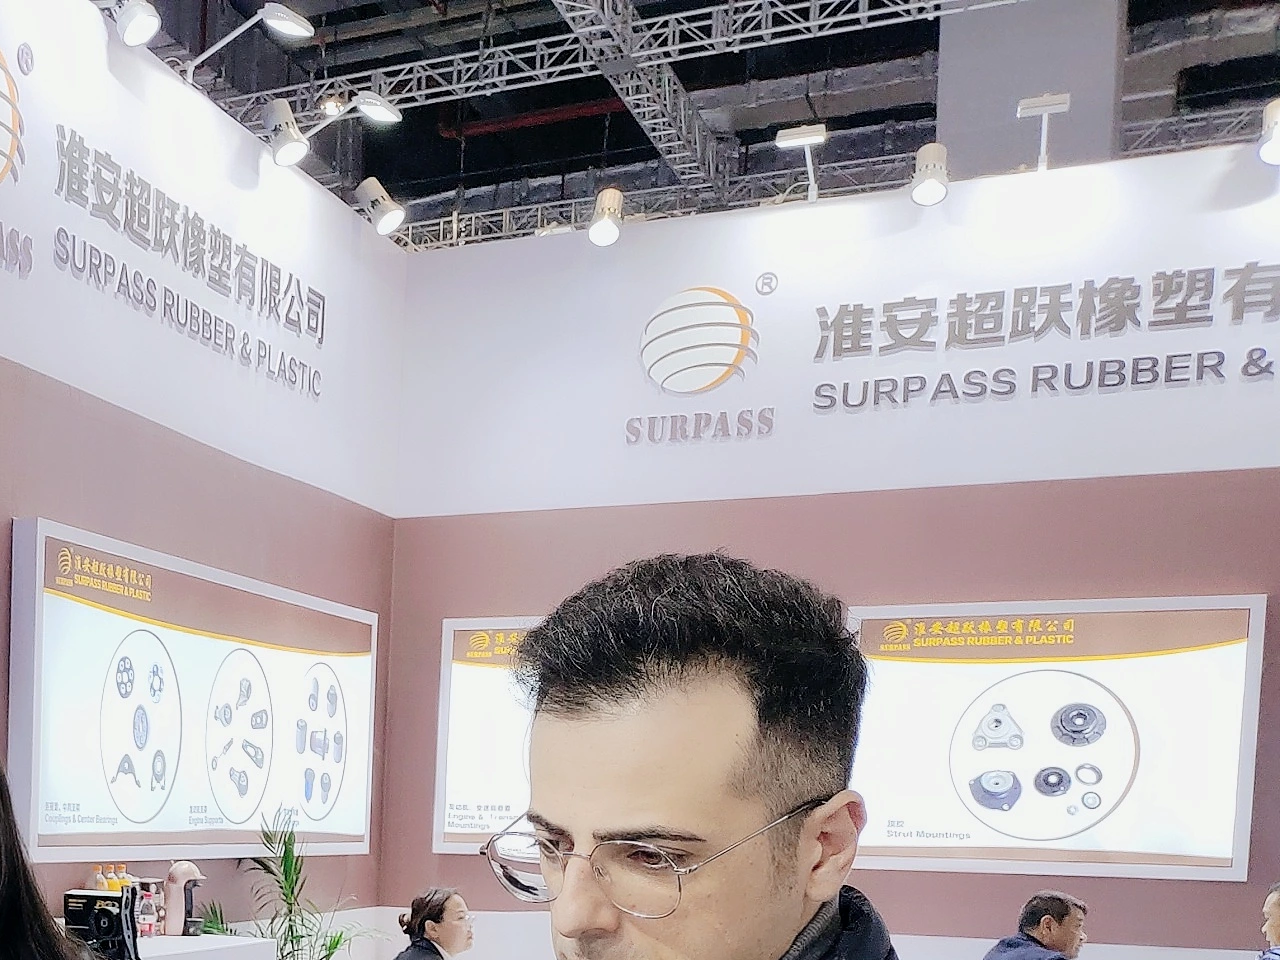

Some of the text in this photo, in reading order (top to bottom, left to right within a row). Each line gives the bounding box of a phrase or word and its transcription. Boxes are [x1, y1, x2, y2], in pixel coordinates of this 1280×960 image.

[55, 124, 326, 346] 淮安超跃橡塑有限公司
[54, 227, 322, 397] SURPASS RUBBER & PLASTIC
[814, 261, 1280, 361] 淮安超跃橡塑有
[813, 347, 1275, 410] SURPASS RUBBER &
[625, 408, 774, 445] SURPASS
[74, 573, 101, 589] SURPASS
[102, 580, 124, 596] RUBBER
[129, 587, 152, 602] PLASTIC
[913, 634, 1074, 648] SURPASS RUBBER & PLASTIC
[448, 821, 490, 830] Mountings
[887, 830, 971, 840] Strut Mountings
